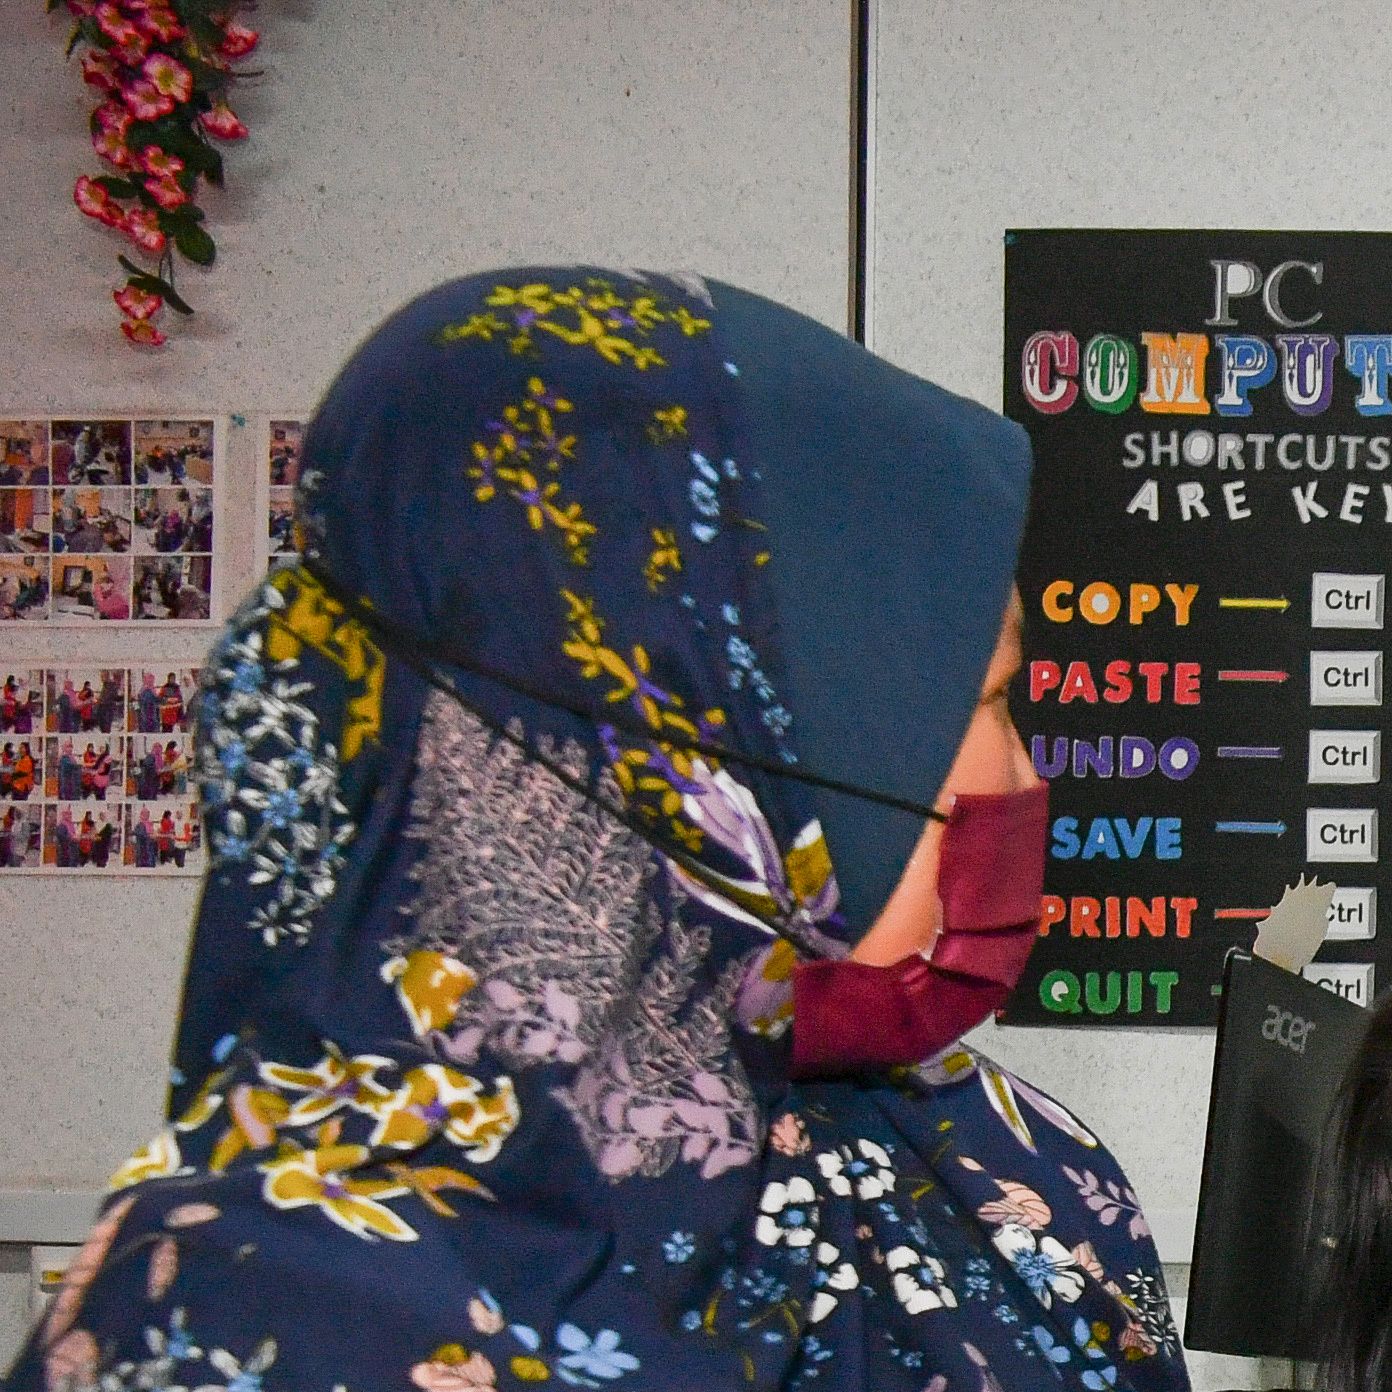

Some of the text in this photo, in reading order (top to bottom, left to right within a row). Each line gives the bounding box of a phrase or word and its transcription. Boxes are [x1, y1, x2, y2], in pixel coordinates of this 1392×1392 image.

[1205, 259, 1324, 328] PC
[1122, 430, 1392, 472] SHORTCUTS
[1126, 479, 1252, 522] ARE
[1042, 580, 1200, 626] COPY
[1325, 589, 1371, 611] Ctrl
[1029, 660, 1201, 706] PASTE
[1323, 666, 1369, 688] Ctrl
[1031, 734, 1201, 780] UNDO
[1321, 745, 1367, 766] Ctrl
[1051, 816, 1183, 860] SAVE
[1320, 823, 1366, 845] Ctrl
[1039, 894, 1199, 938] PRINT
[1039, 969, 1179, 1015] QUIT
[1261, 1004, 1317, 1055] acer
